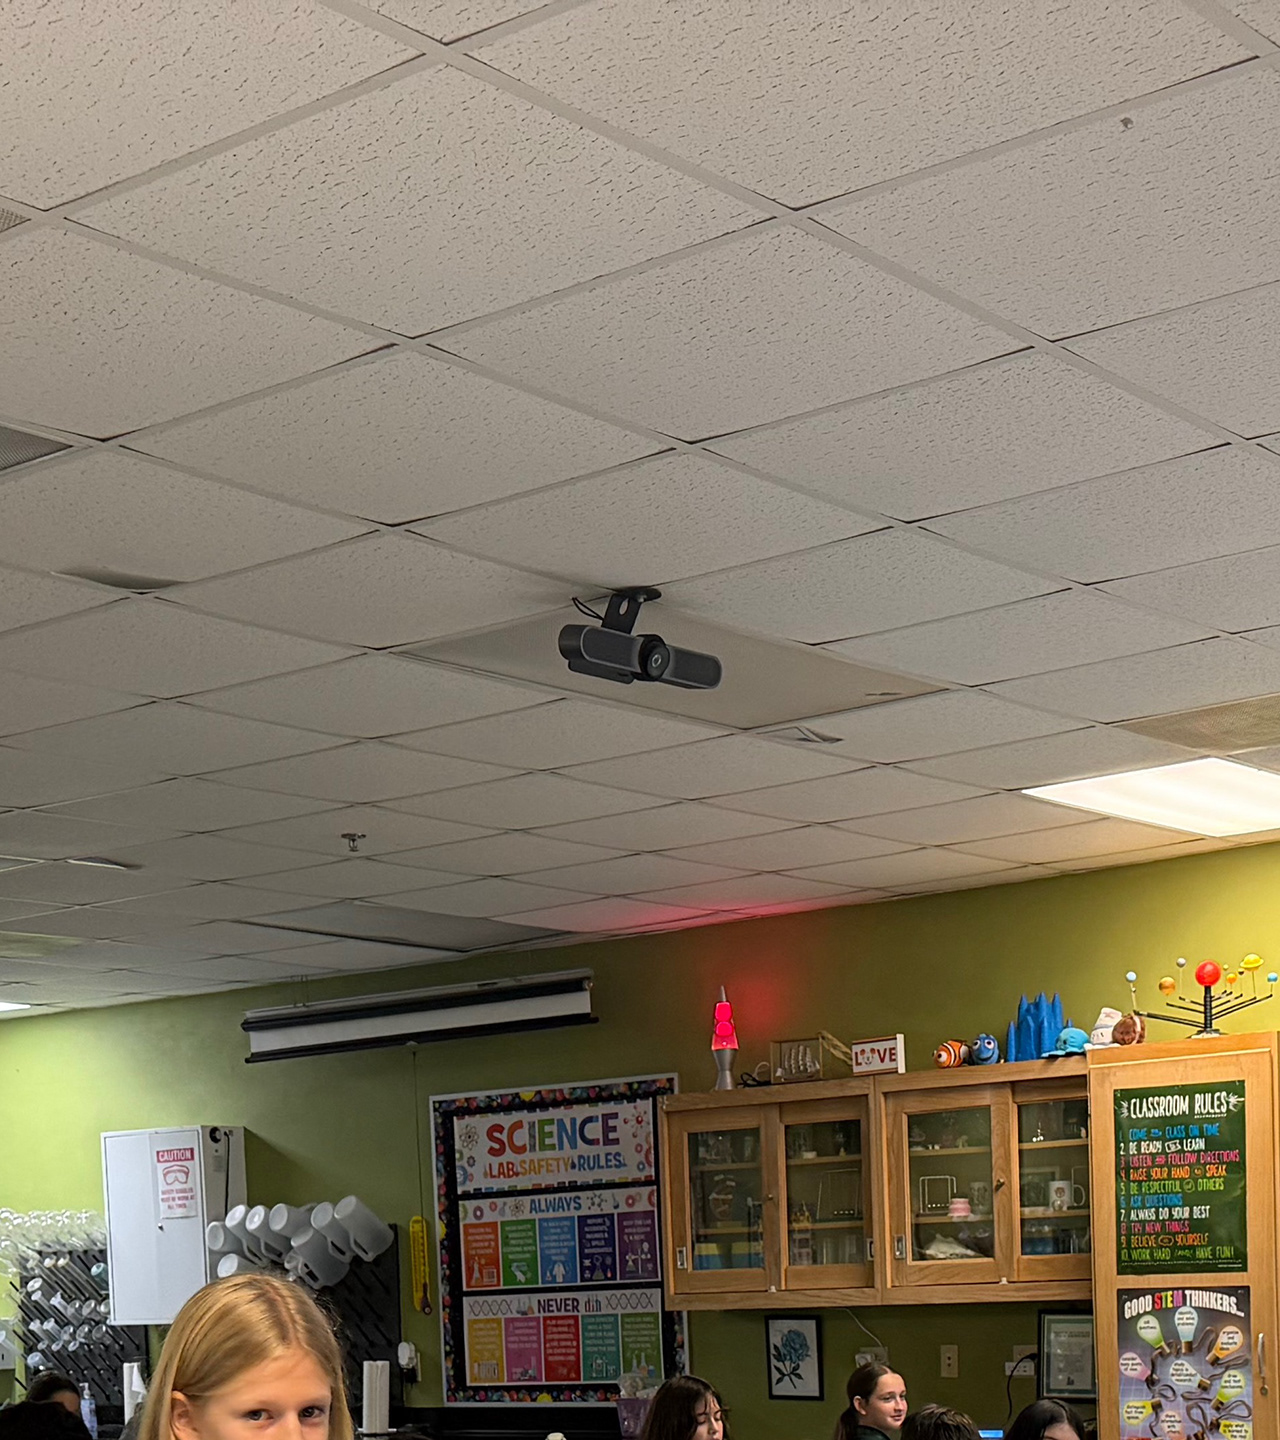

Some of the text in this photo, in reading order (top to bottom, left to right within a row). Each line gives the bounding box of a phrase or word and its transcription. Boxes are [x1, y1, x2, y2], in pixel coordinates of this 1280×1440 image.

[1130, 1091, 1227, 1119] CLASSROOM RULES
[486, 1112, 620, 1158] SCIENCE
[1129, 1123, 1220, 1140] COME CLASS ON TIME
[1141, 1140, 1162, 1153] READY
[1183, 1138, 1205, 1151] LEARN
[159, 1150, 191, 1161] CAUTION
[1130, 1155, 1152, 1167] LISTEN
[1168, 1153, 1197, 1165] FOLLOW
[1200, 1150, 1239, 1163] DIRECTIONS
[488, 1152, 621, 1179] LAB SAFETY RULES
[1130, 1168, 1148, 1180] RAISE
[1150, 1167, 1168, 1179] YOUR
[1172, 1166, 1190, 1178] HAND
[1205, 1164, 1227, 1177] SPEAK
[1141, 1180, 1182, 1193] RESPECTFUL
[1197, 1178, 1225, 1191] OTHERS
[529, 1195, 582, 1214] ALWAYS
[1130, 1195, 1142, 1207] ASK
[1145, 1193, 1183, 1207] QUESTIONS
[1130, 1208, 1156, 1221] ALWAYS
[1158, 1207, 1169, 1219] DO
[1171, 1206, 1190, 1219] YOUR
[1193, 1206, 1210, 1218] BEST
[1131, 1222, 1142, 1235] TRY
[1145, 1222, 1162, 1234] NEW
[1165, 1221, 1190, 1232] THINGS
[1131, 1235, 1157, 1247] BELIEVE
[1175, 1233, 1208, 1246] YOURSELF
[1130, 1249, 1150, 1259] WORK
[1153, 1248, 1171, 1259] HARD
[1196, 1247, 1213, 1258] HAVE
[1216, 1246, 1234, 1258] FUN!
[538, 1298, 580, 1314] NEVER
[1124, 1294, 1152, 1319] GOOD
[1154, 1290, 1183, 1311] STEM
